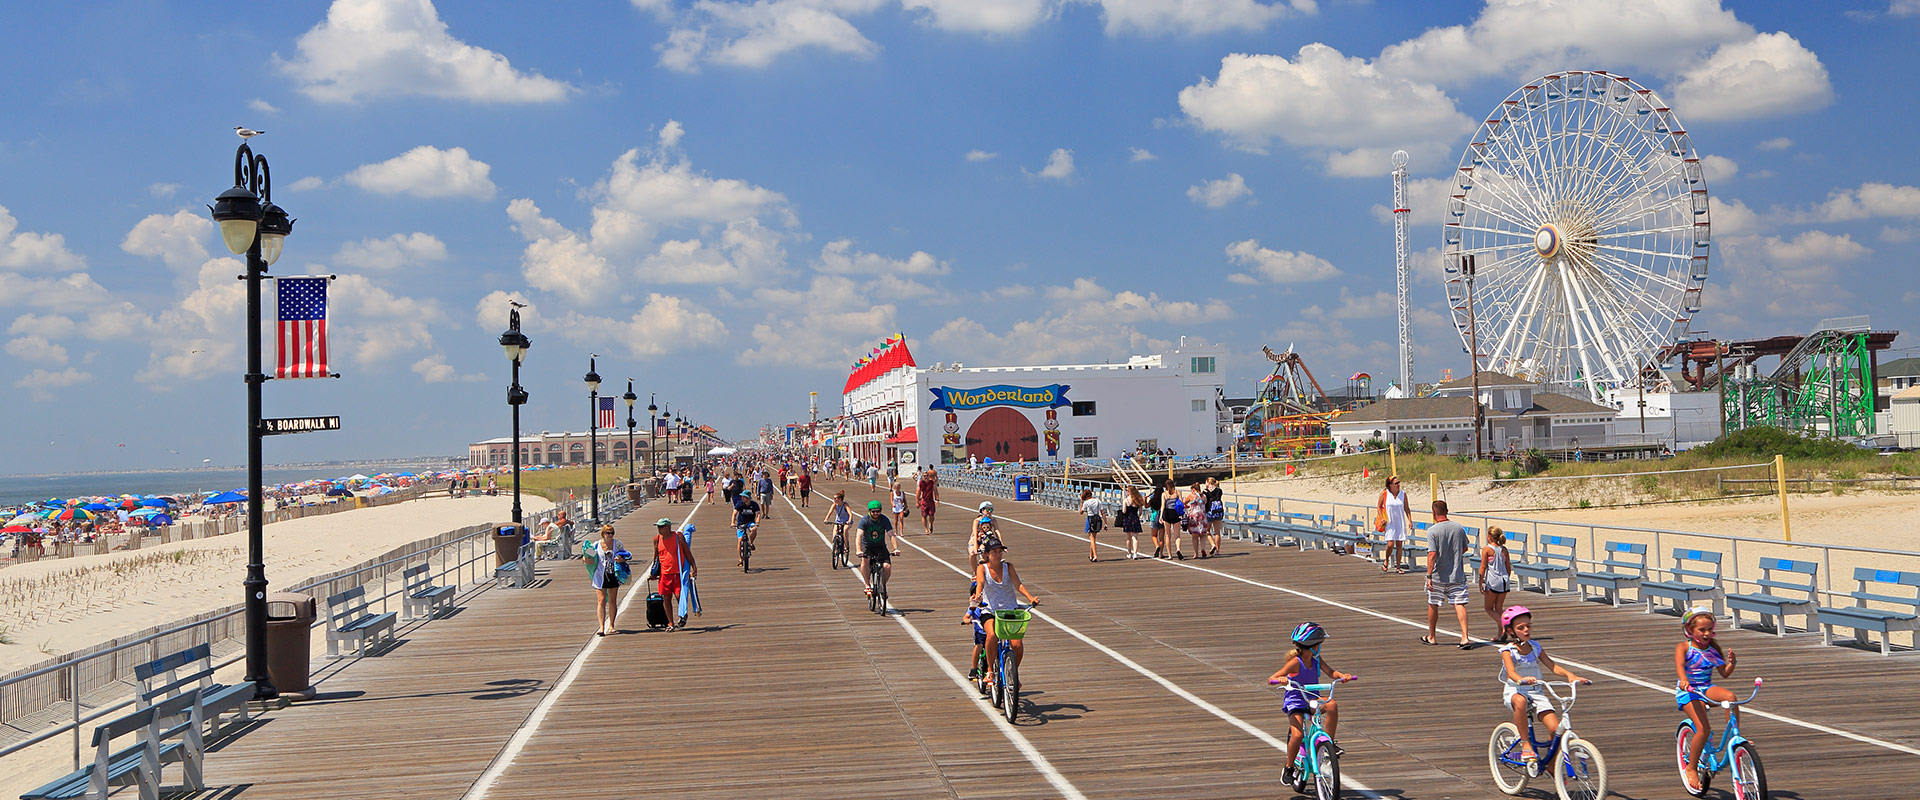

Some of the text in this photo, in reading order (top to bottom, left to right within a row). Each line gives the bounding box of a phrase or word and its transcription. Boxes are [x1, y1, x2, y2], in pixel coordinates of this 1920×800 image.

[947, 389, 1054, 406] Wonderland
[277, 418, 326, 431] BOARDWALK
[329, 417, 339, 428] MI
